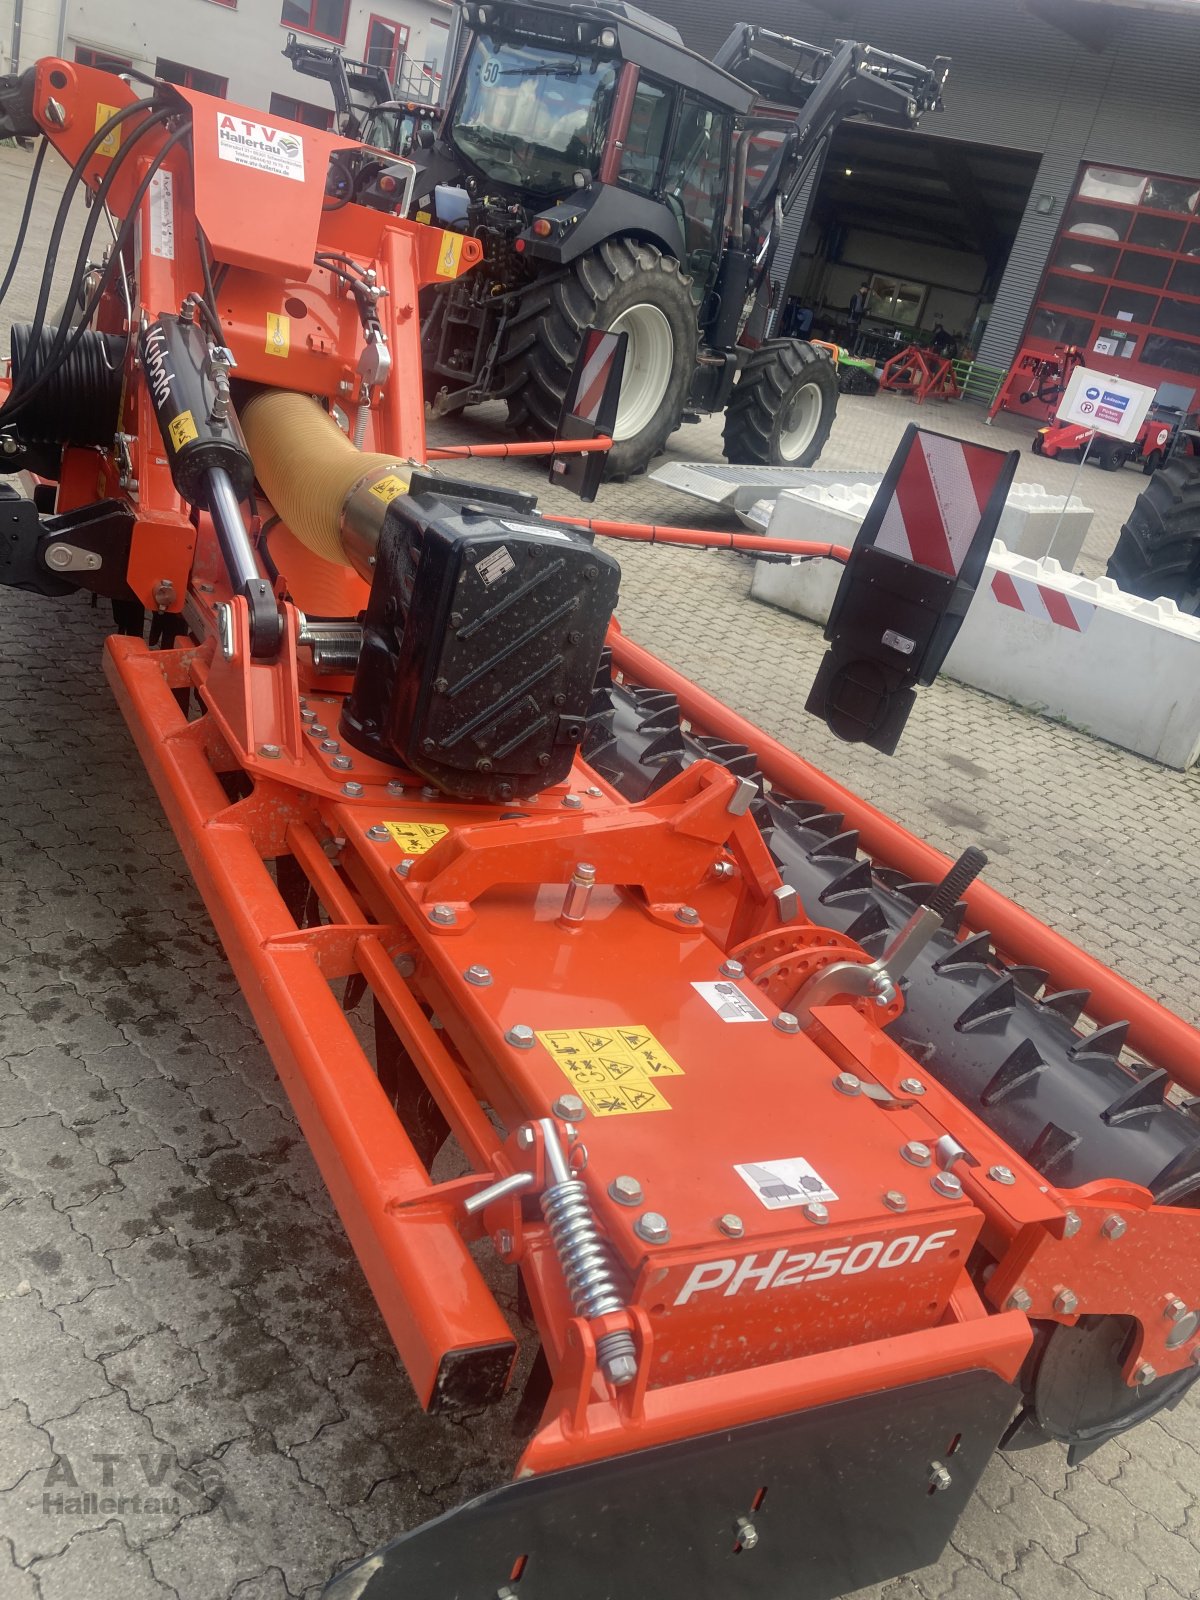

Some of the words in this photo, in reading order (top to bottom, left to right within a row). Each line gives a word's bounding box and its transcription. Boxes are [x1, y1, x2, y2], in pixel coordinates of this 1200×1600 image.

[483, 62, 500, 83] 50
[220, 129, 281, 155] Hallertau
[144, 327, 176, 411] Kubota
[673, 1229, 957, 1306] PH2500F
